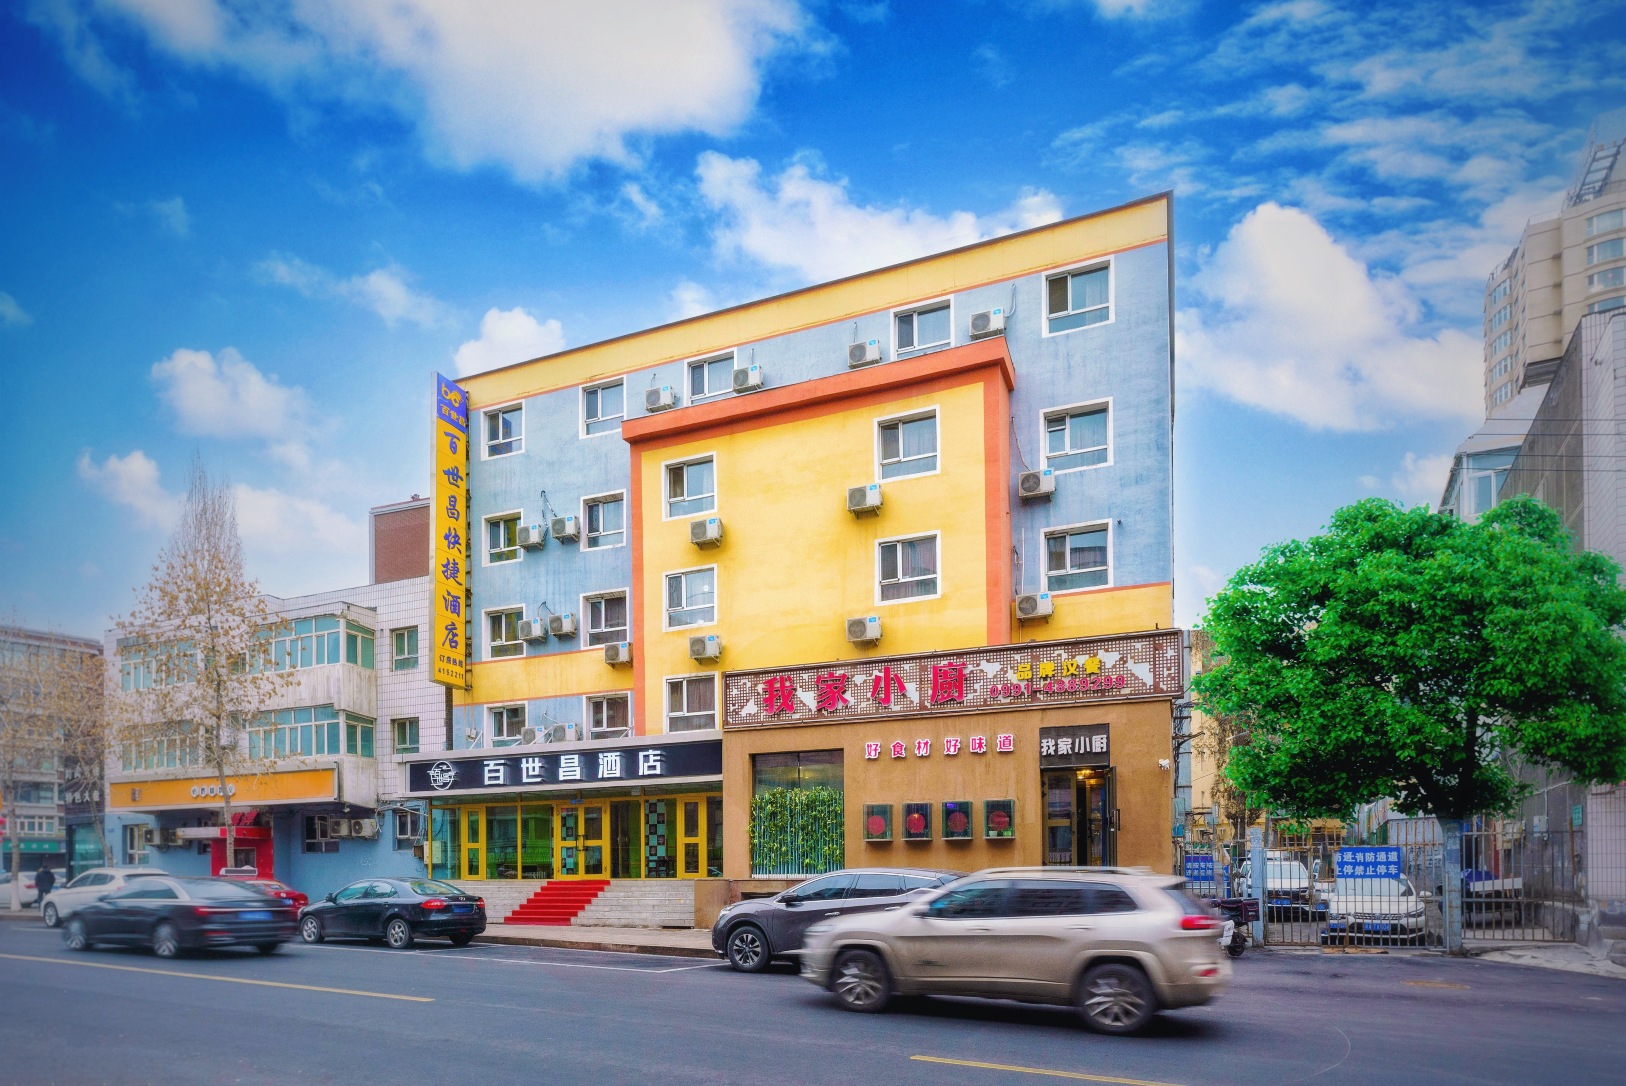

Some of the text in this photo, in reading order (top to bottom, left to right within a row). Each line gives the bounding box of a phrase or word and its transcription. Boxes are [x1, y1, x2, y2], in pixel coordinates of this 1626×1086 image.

[440, 403, 466, 428] 百世昌
[441, 431, 464, 649] 百世昌快捷酒店
[1017, 656, 1101, 680] 品牌汉餐
[989, 674, 1125, 698] 0991-4889299
[865, 734, 1014, 759] 好食材 好味道
[1041, 734, 1108, 757] 我家小厨
[483, 750, 663, 786] 百世昌酒店
